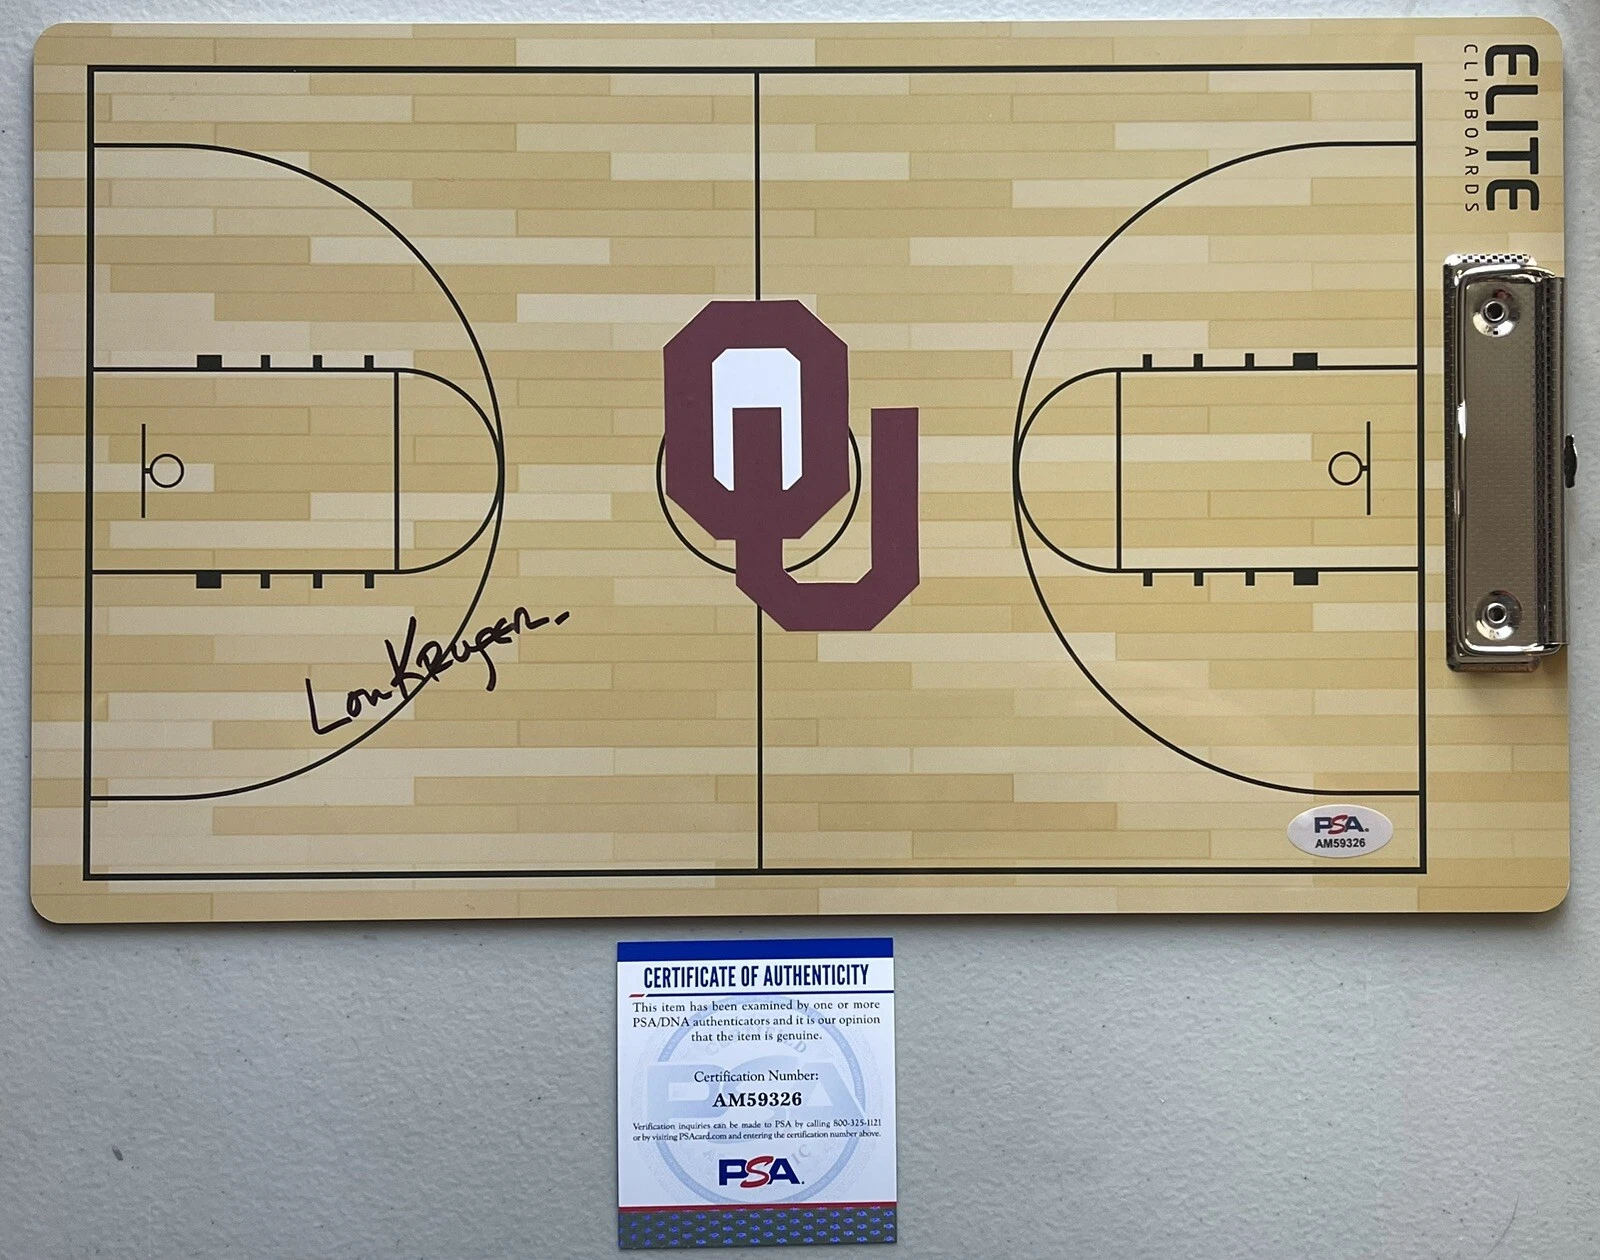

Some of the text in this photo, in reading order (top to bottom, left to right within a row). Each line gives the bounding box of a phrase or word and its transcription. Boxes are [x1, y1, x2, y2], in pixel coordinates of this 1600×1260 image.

[1464, 44, 1479, 211] CLIPBOARDS
[1485, 44, 1540, 211] ELITE
[305, 678, 393, 735] Lon
[1314, 815, 1369, 835] PSA
[1315, 838, 1366, 849] AM59326
[644, 964, 870, 988] CERTIFICATE OF AUTHENTICITY
[632, 1002, 657, 1012] This
[662, 1002, 685, 1012] item
[690, 1001, 708, 1011] has
[712, 1000, 737, 1011] been
[742, 1000, 793, 1010] examined
[797, 1000, 809, 1011] by
[632, 1017, 690, 1028] PSA/DNA
[693, 1016, 770, 1026] authenticators
[773, 1015, 793, 1025] and
[796, 1015, 803, 1025] it
[807, 1015, 815, 1025] is
[839, 1015, 881, 1026] opinion
[691, 1030, 822, 1042] that the item is genuine.
[694, 1069, 819, 1082] Certification Number:
[712, 1092, 802, 1107] AM59326
[633, 1122, 675, 1131] Verification
[678, 1122, 710, 1131] inquiries
[741, 1120, 761, 1129] made
[775, 1120, 792, 1128] PSA
[795, 1120, 804, 1129] by
[806, 1119, 831, 1128] calling
[833, 1118, 882, 1127] 800-325-1121
[642, 1133, 650, 1142] by
[652, 1133, 678, 1142] visiting
[679, 1132, 727, 1140] PSAcard.com
[728, 1131, 742, 1139] and
[743, 1131, 773, 1140] entering
[774, 1131, 785, 1139] the
[786, 1130, 828, 1139] certification
[829, 1129, 857, 1138] number
[858, 1129, 882, 1138] above.
[718, 1156, 805, 1188] PSA
